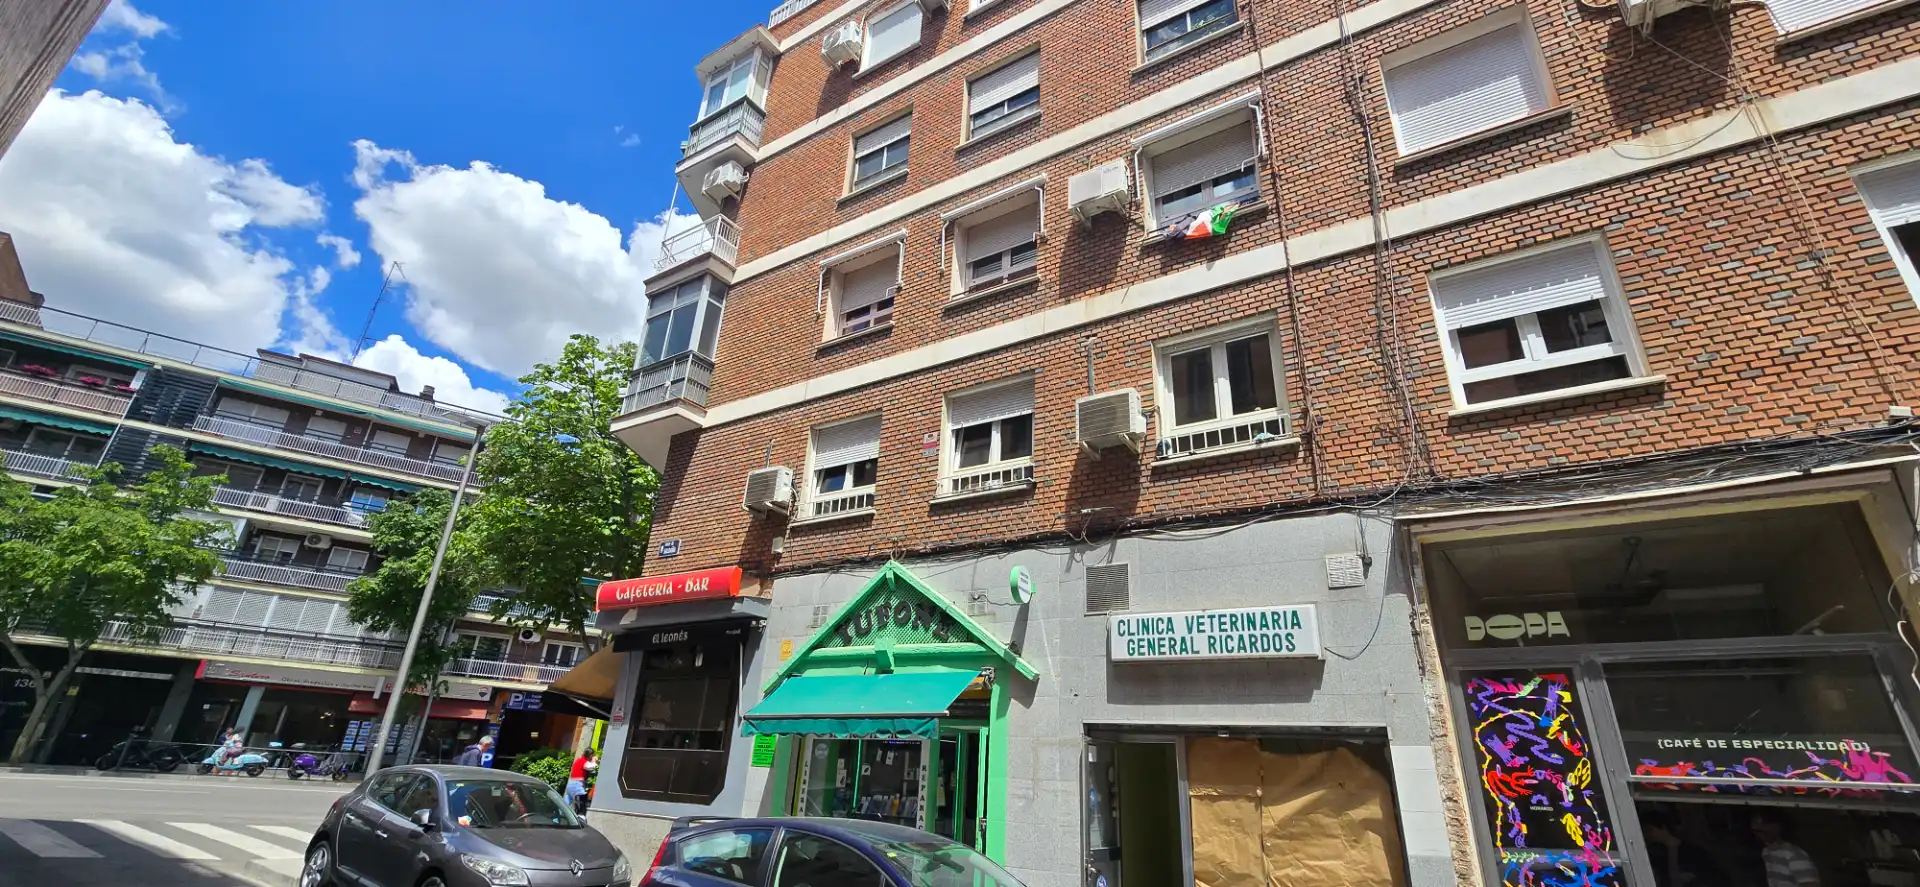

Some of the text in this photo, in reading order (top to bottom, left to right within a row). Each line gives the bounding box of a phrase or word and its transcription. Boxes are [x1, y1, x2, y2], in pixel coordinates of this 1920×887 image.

[1117, 610, 1302, 637] CLINICA VETERINARIA
[1464, 611, 1571, 641] DOPA
[1127, 632, 1296, 657] GENERAL RICARDOS
[1708, 740, 1728, 748] DE
